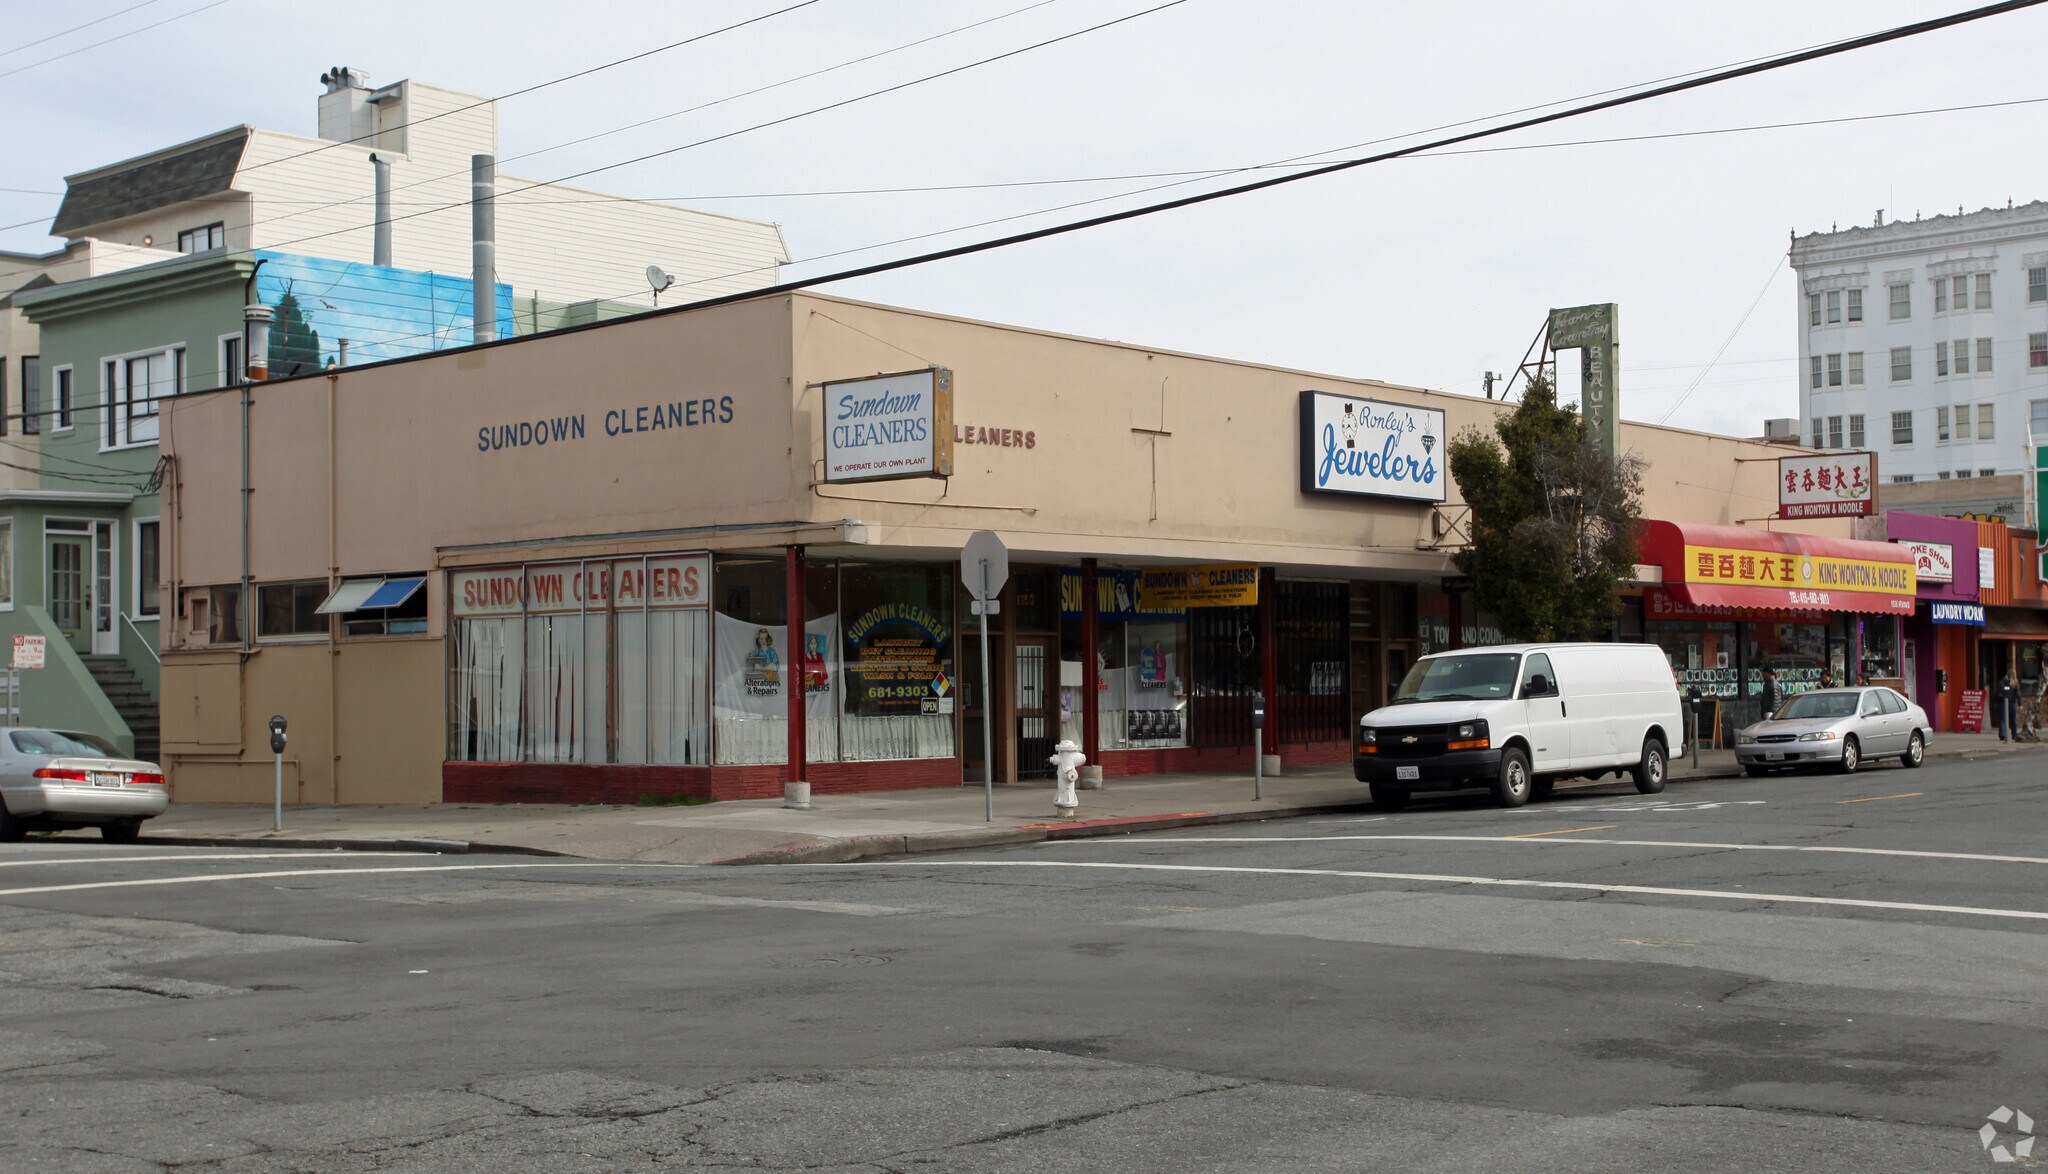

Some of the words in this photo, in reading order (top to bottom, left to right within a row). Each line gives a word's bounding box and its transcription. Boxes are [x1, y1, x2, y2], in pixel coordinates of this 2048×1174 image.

[1590, 346, 1604, 431] BEAUTY
[837, 390, 921, 421] Sundown
[478, 414, 585, 451] SUNDOWN
[605, 395, 734, 436] CLEANERS
[833, 417, 927, 449] CLEANERS
[1360, 405, 1416, 448] Ronley's
[953, 424, 1036, 449] LEANERS
[834, 465, 843, 473] WE
[845, 462, 872, 472] OPERATE
[873, 461, 887, 469] OUR
[888, 459, 904, 468] OWN
[905, 456, 926, 466] PLANT
[1319, 422, 1438, 487] Jewelers
[1785, 465, 1864, 493] 雲吞麵大王
[1787, 505, 1803, 517] KING
[1804, 504, 1830, 516] WONTON
[1832, 503, 1837, 514] &
[1837, 502, 1863, 513] NOODLE
[1698, 552, 1795, 582] 雲吞麵大王
[1929, 548, 1950, 569] SHOP
[1144, 571, 1187, 589] SUNDOWN
[1209, 568, 1255, 586] CLEANERS
[1818, 562, 1837, 584] KING
[1839, 564, 1871, 586] WONTON
[1872, 566, 1877, 586] &
[1878, 566, 1907, 589] NOODLE
[464, 573, 563, 609] SUNDOWN
[848, 603, 896, 643] SUNDOWN
[898, 602, 947, 643] CLEANERS
[1932, 603, 1963, 620] LAUNDRY
[14, 636, 24, 645] NO
[744, 679, 780, 688] Alterations
[908, 672, 934, 680] FOLD
[753, 687, 778, 696] Repairs
[869, 686, 929, 698] 681-9303
[922, 701, 937, 711] OPEN
